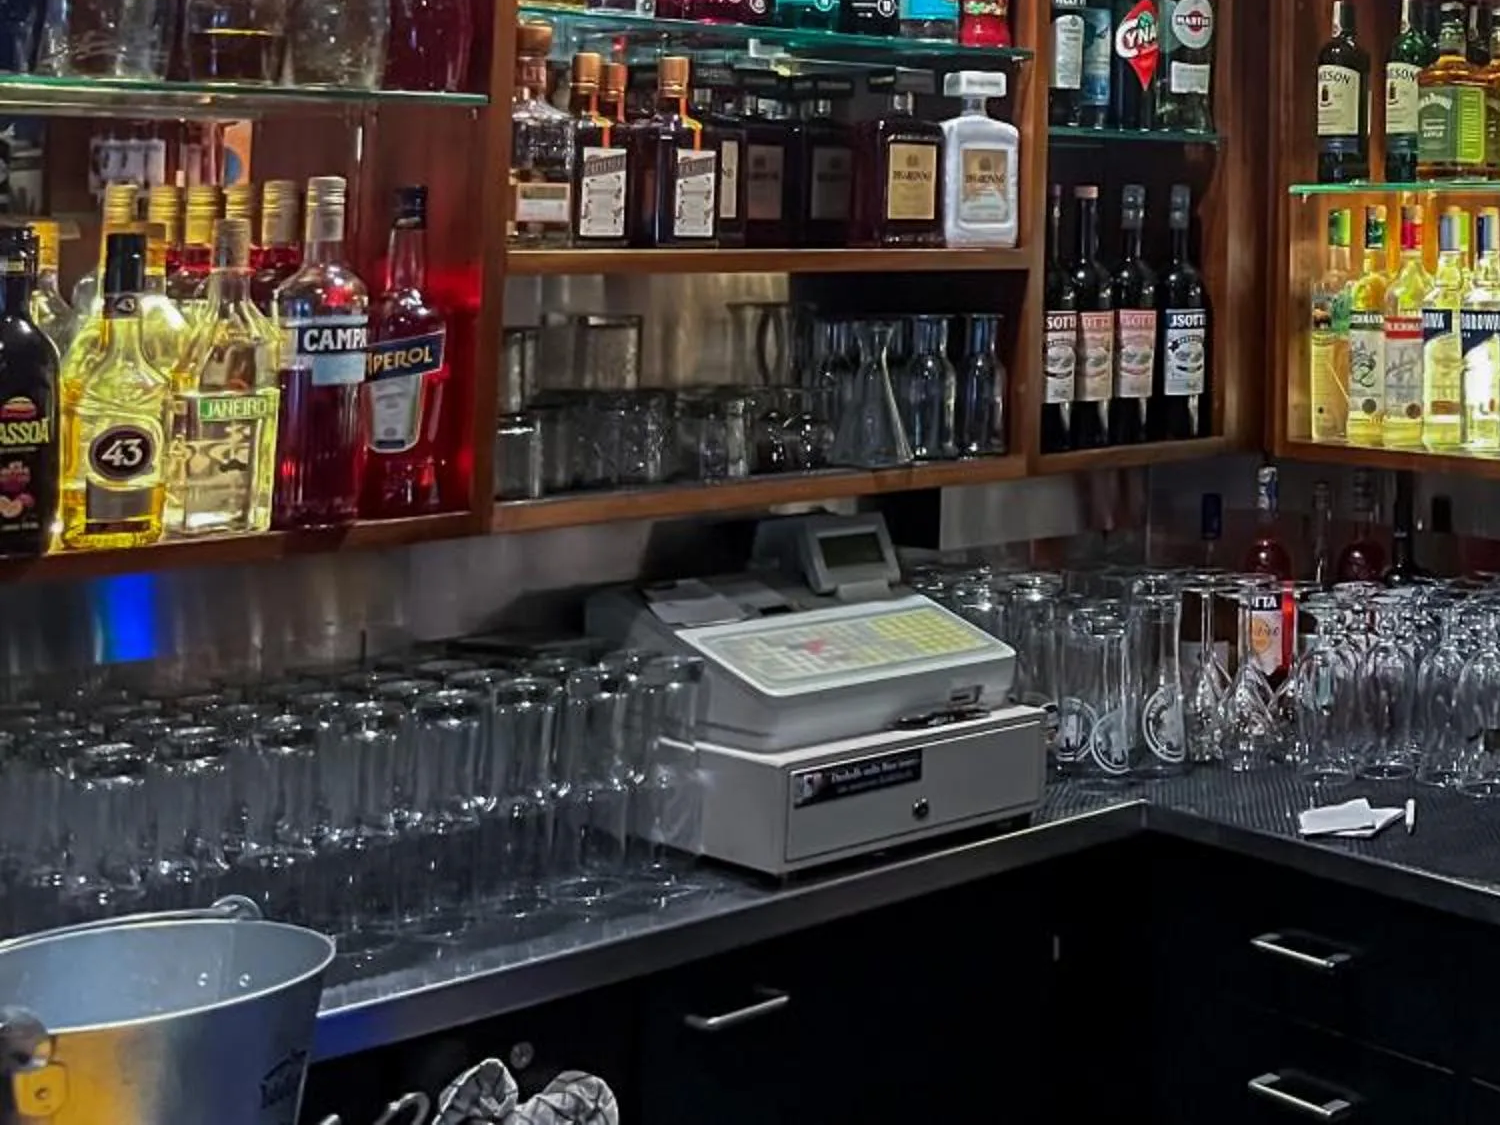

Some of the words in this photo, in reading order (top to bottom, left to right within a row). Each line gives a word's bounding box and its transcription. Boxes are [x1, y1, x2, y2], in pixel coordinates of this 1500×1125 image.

[1115, 17, 1158, 59] CYNA
[207, 396, 268, 419] JANEIRO
[101, 437, 145, 467] 43
